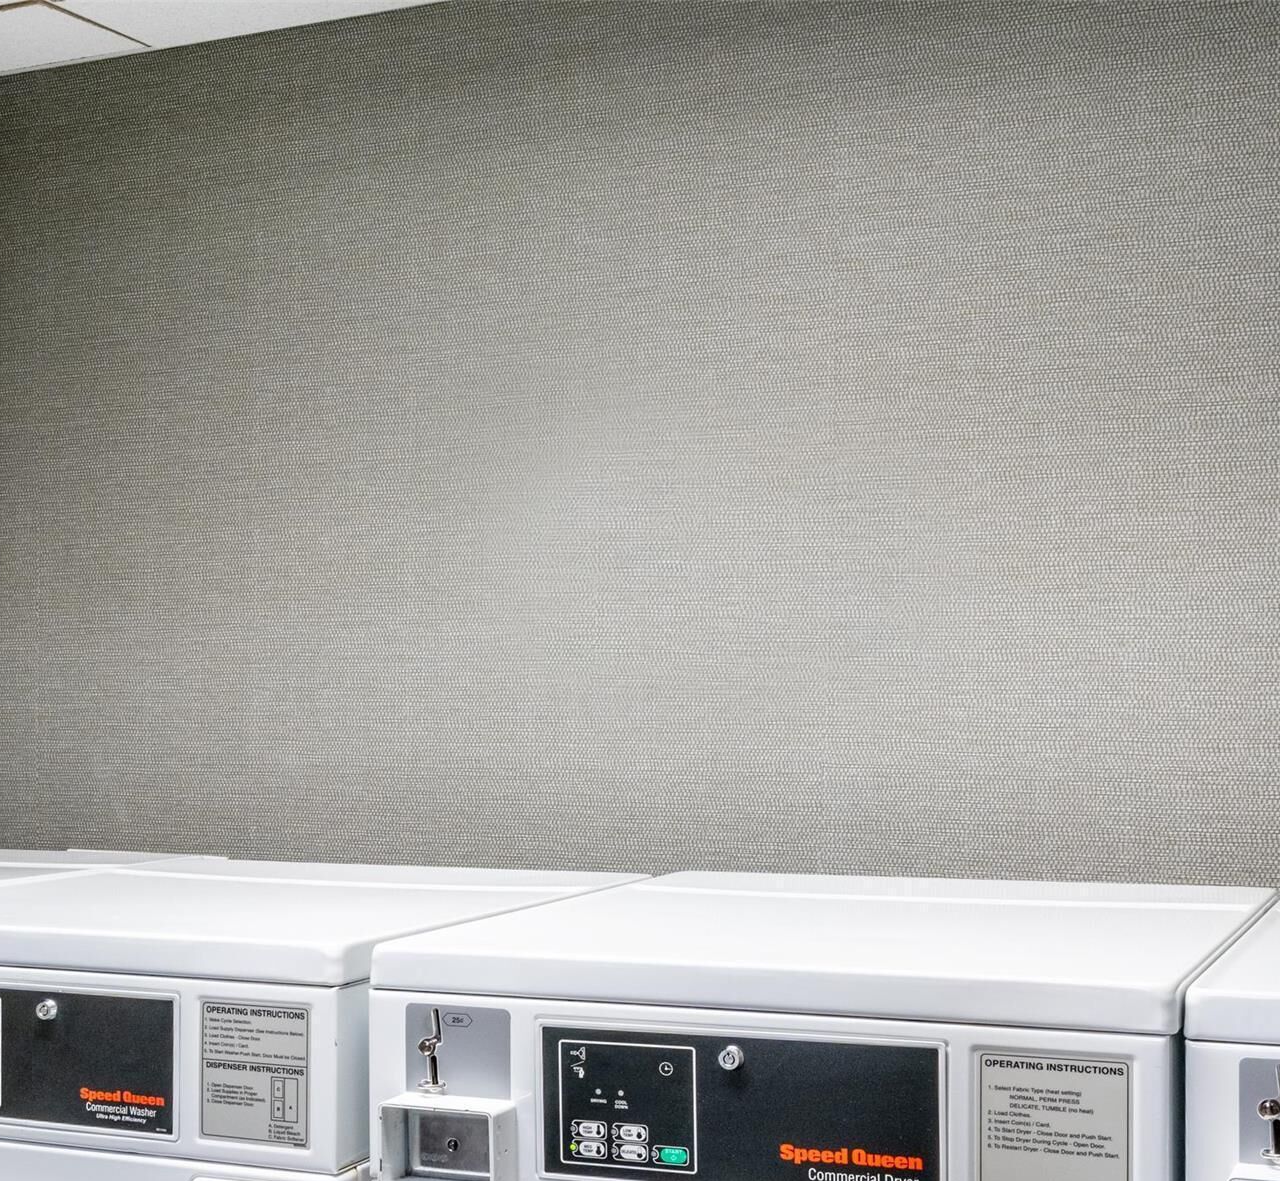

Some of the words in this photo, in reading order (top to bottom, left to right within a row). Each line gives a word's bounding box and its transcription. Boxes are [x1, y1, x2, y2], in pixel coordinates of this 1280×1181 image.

[206, 1006, 248, 1016] OPERATING
[250, 1009, 305, 1020] INSTRUCTIONS
[206, 1062, 247, 1071] DISPENSER
[250, 1065, 304, 1076] INSTRUCTIONS
[985, 1059, 1043, 1070] OPERATING
[1047, 1064, 1124, 1076] INSTRUCTIONS
[80, 1087, 120, 1101] Speed
[123, 1091, 164, 1106] Queen
[86, 1102, 127, 1114] Commercial
[130, 1106, 156, 1117] Washer
[1010, 1103, 1040, 1111] DELICATE,
[122, 1116, 146, 1124] Efficiency
[780, 1144, 848, 1164] Speed
[852, 1149, 923, 1170] Queen
